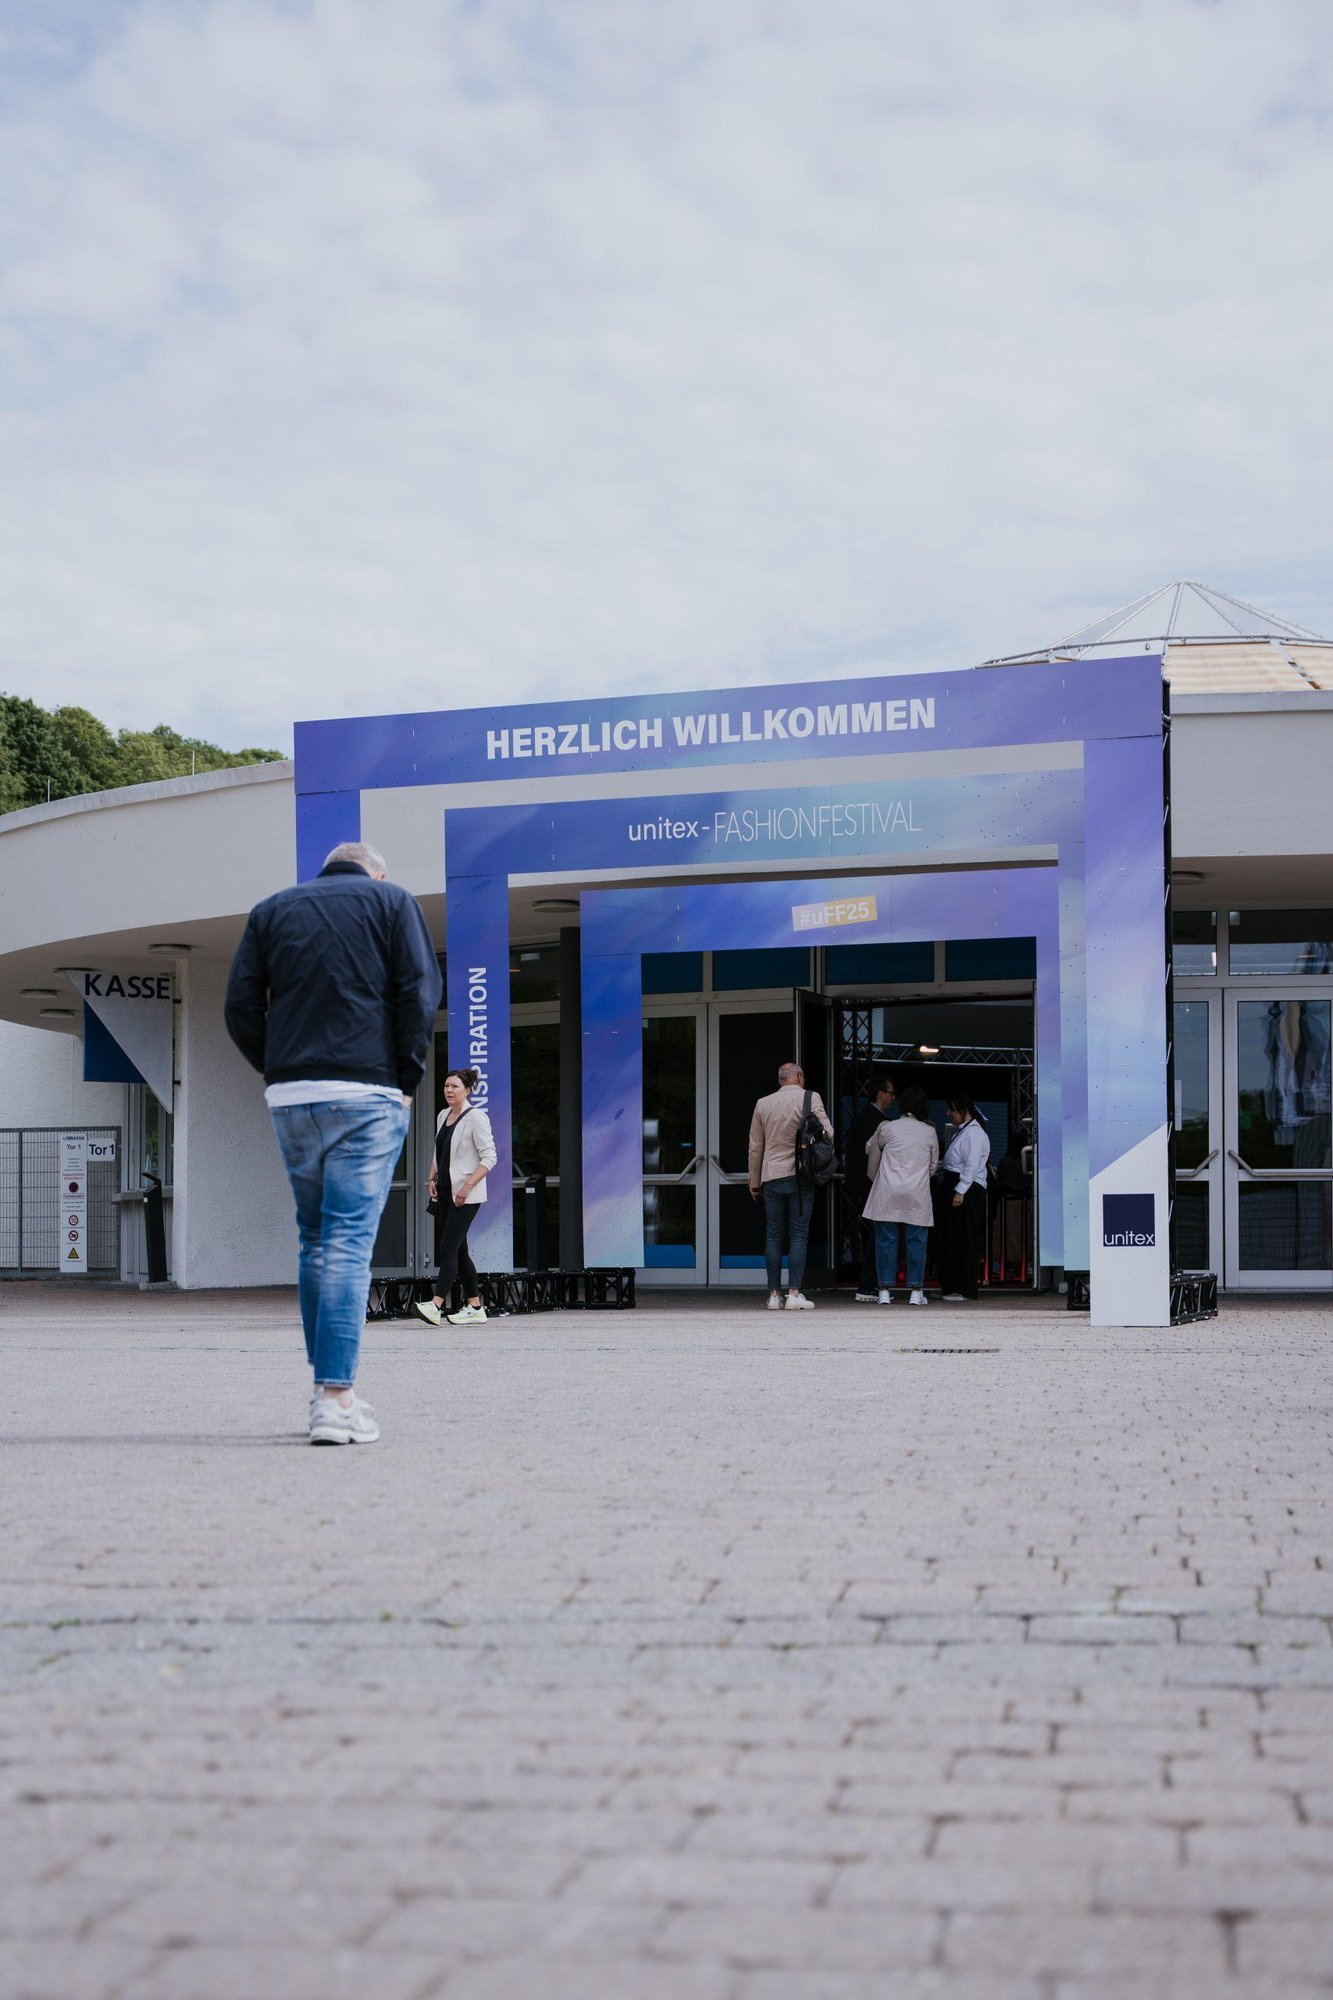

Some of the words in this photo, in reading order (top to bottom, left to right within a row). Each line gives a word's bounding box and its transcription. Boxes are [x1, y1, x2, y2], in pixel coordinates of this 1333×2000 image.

[486, 717, 663, 760] HERZLICH
[672, 697, 936, 746] WILLKOMMEN
[799, 901, 870, 927] #uFF25
[84, 973, 170, 999] KASSE
[468, 967, 489, 1113] NSPIRATION
[88, 1144, 107, 1155] Tor
[109, 1144, 114, 1155] 1
[1104, 1230, 1154, 1245] unitex
